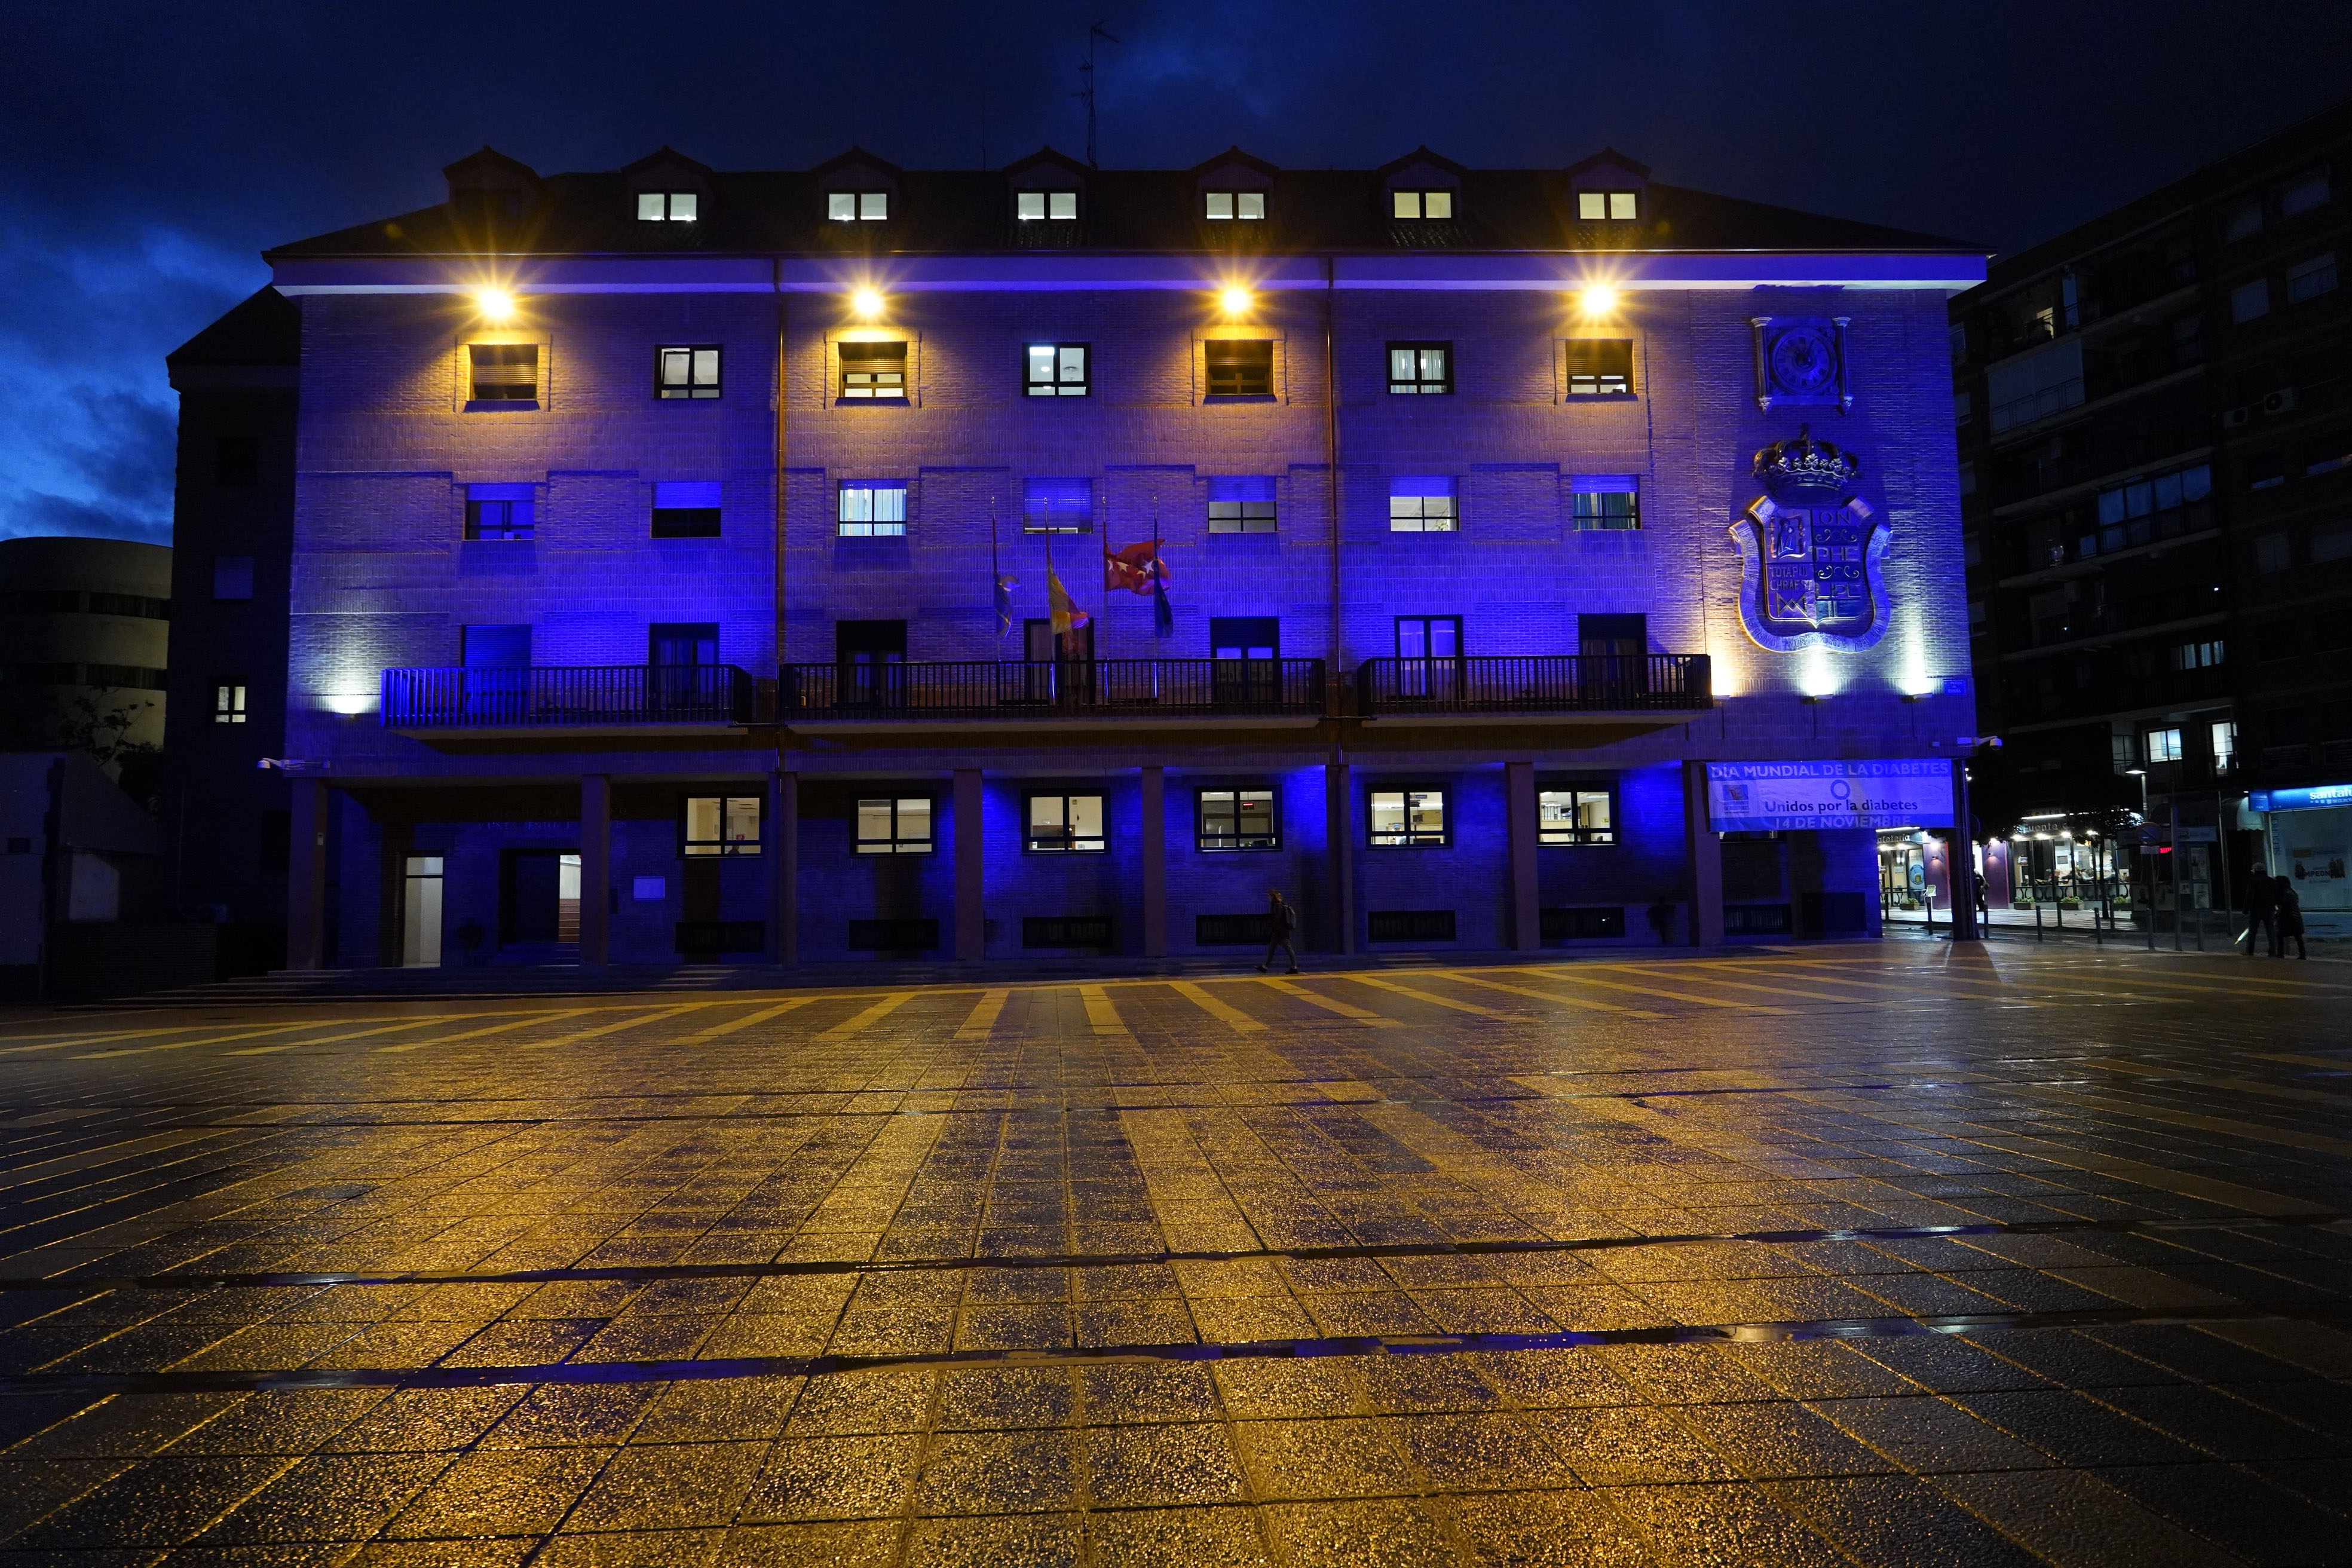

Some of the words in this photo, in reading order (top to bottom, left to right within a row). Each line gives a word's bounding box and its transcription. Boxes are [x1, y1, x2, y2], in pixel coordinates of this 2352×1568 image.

[1743, 765, 1820, 777] MUNDIAL
[1823, 764, 1843, 776] DE
[1848, 764, 1869, 776] LA
[1872, 763, 1948, 775] DIABETES
[1765, 801, 1814, 812] Unidos
[1818, 803, 1842, 814] por
[1846, 800, 1858, 810] la
[1861, 800, 1918, 810] diabetes
[1775, 817, 1790, 829] 14
[1795, 817, 1816, 828] DE
[1821, 816, 1912, 828] NOVIEMBRE
